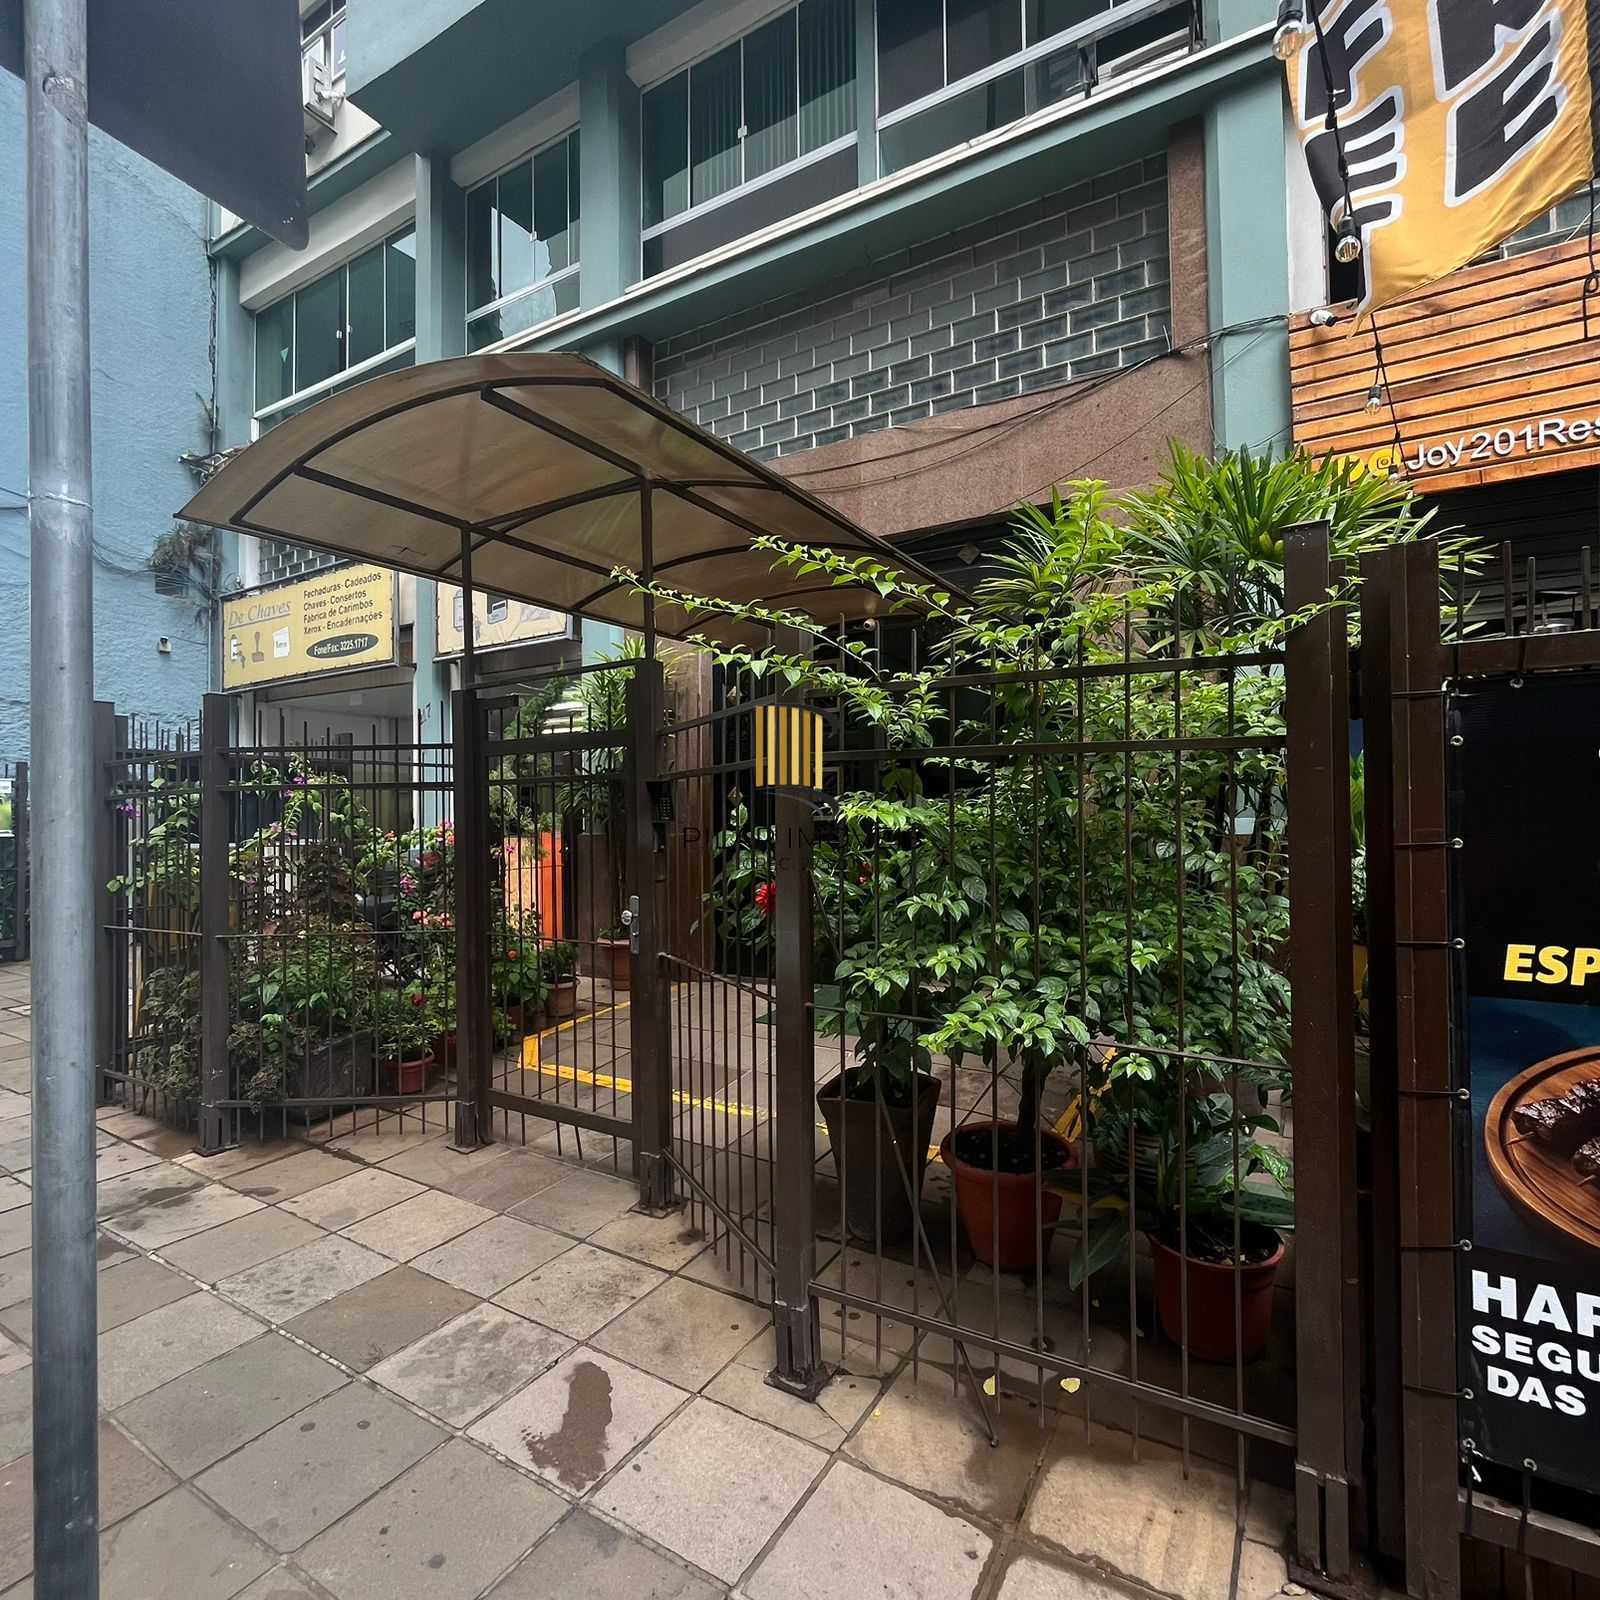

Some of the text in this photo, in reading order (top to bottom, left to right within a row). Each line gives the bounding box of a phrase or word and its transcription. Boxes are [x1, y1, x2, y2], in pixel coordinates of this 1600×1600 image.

[304, 583, 342, 600] Fechaduras
[344, 572, 382, 589] Cadeados
[229, 601, 292, 626] De Chaves
[304, 599, 327, 611] Chaves
[330, 590, 367, 605] Consertos
[328, 608, 337, 618] de
[338, 600, 374, 615] Carimbos
[303, 625, 322, 636] Xerox
[326, 611, 383, 631] Encadernações
[1503, 943, 1600, 986] ESP
[1471, 1324, 1600, 1384] SEGU
[1487, 1365, 1587, 1417] DAS
